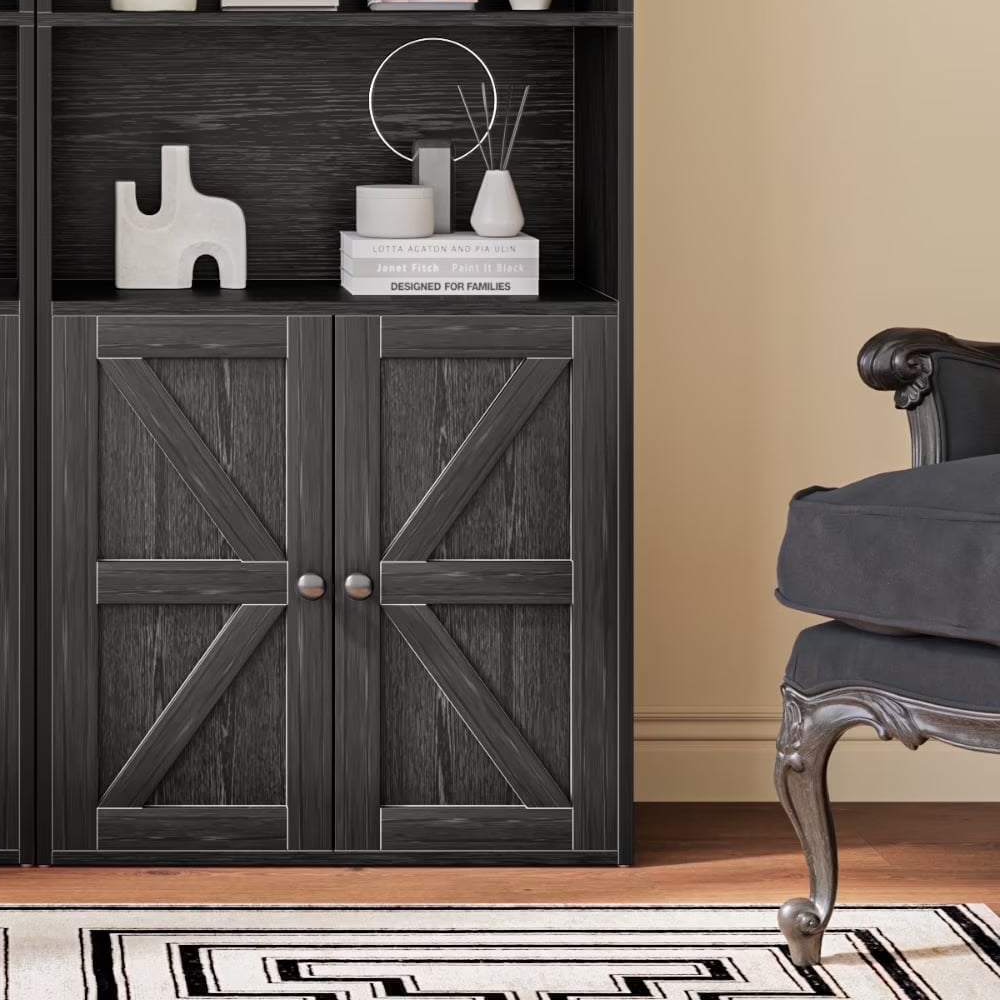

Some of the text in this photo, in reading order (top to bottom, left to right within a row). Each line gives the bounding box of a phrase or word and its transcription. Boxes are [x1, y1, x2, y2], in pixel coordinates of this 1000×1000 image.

[372, 245, 403, 253] LOTTA
[450, 245, 471, 253] AND
[475, 245, 490, 253] PIA
[376, 263, 440, 273] Janet Fitch
[452, 263, 525, 273] Paint It Black
[390, 282, 511, 291] DESIGNED FOR FAMILIES
